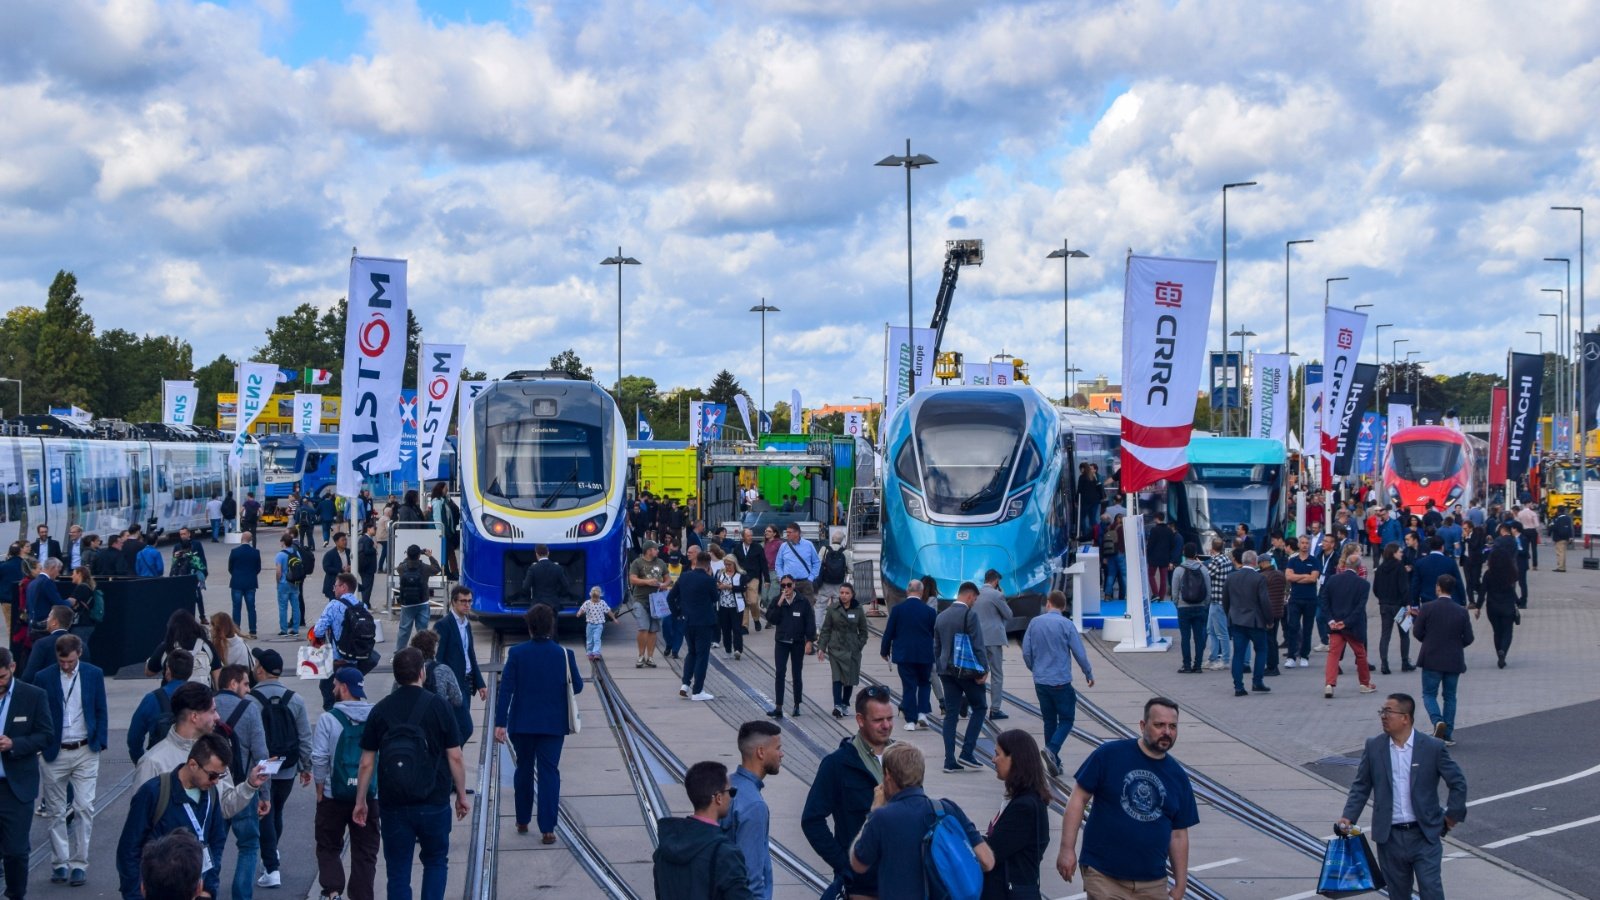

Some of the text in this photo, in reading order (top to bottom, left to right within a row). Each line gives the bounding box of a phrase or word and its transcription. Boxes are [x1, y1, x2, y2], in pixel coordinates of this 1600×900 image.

[351, 272, 392, 479] ALSTOM
[914, 345, 924, 377] Europe
[1147, 315, 1177, 406] CRRC
[1273, 368, 1281, 394] Europe
[1330, 355, 1347, 414] CRR
[421, 352, 452, 471] ALSTOM
[1337, 383, 1364, 457] HITACHI
[1510, 375, 1533, 461] HITACHI
